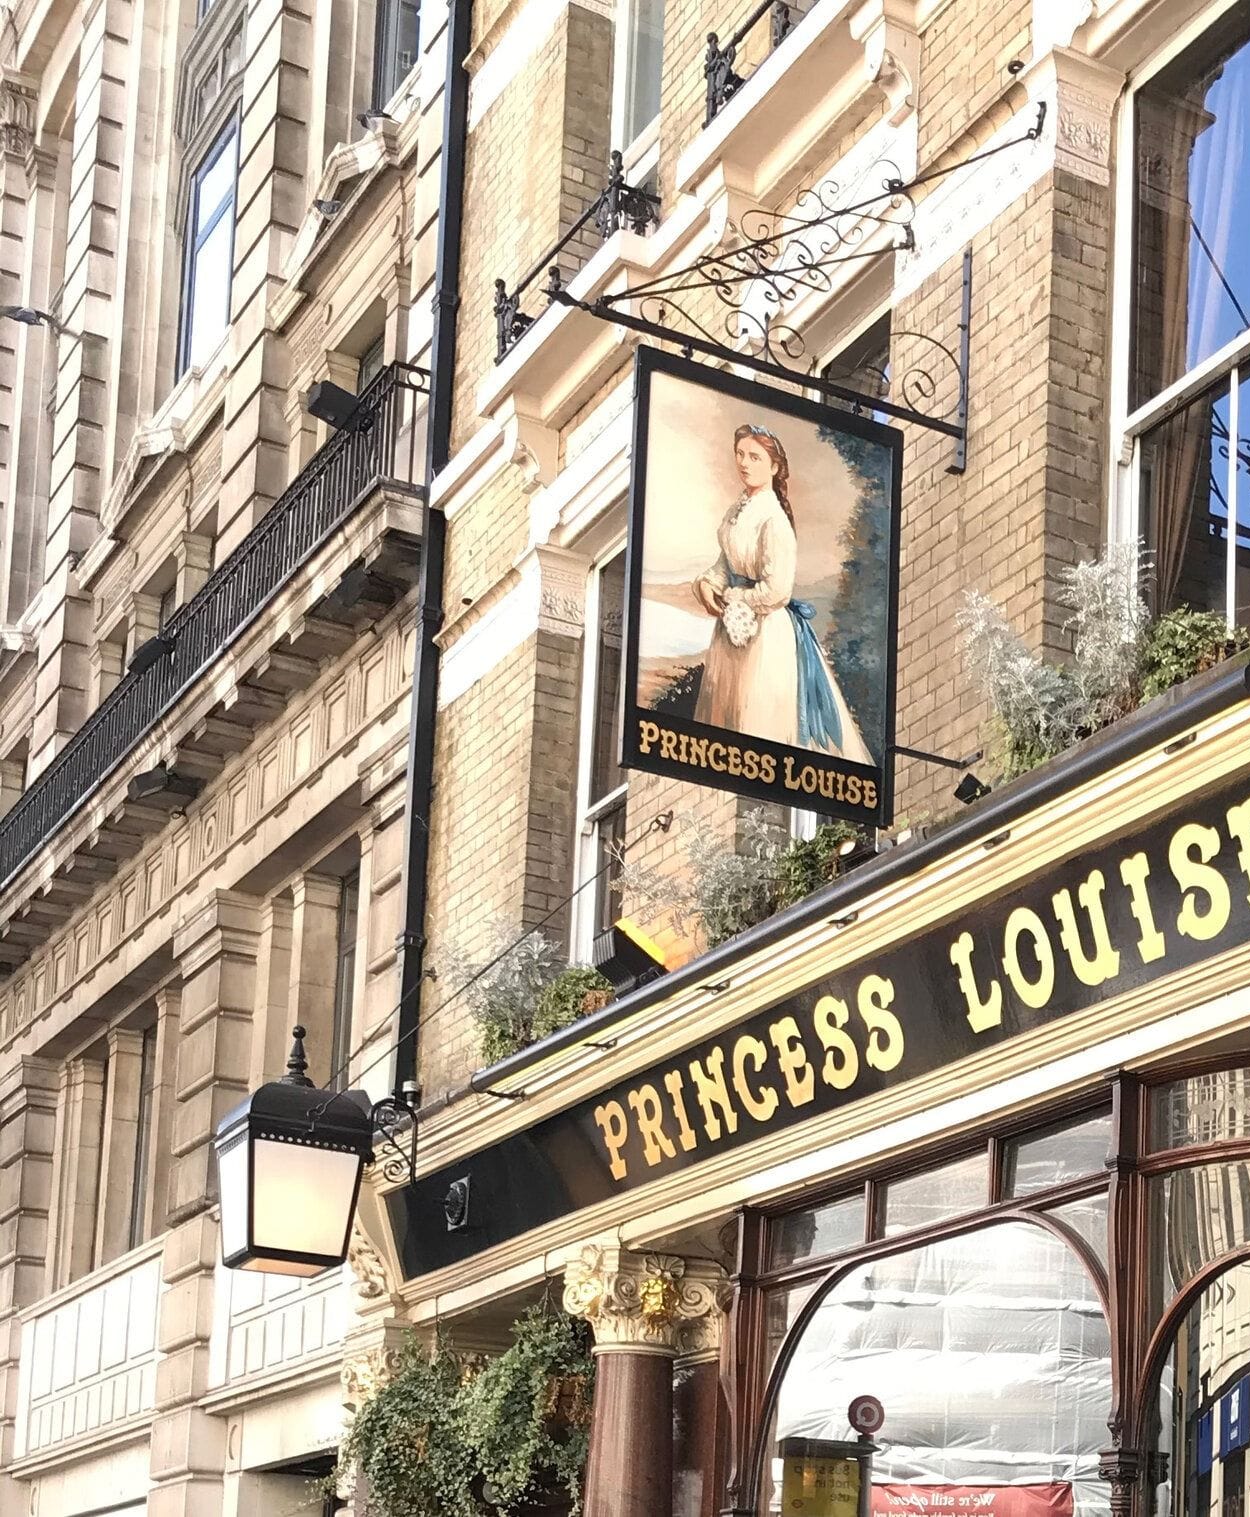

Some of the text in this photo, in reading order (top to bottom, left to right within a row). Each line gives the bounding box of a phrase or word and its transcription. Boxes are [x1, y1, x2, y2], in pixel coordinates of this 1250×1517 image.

[639, 720, 878, 809] PRINCESS LOUISE
[595, 974, 905, 1180] PRINCESS
